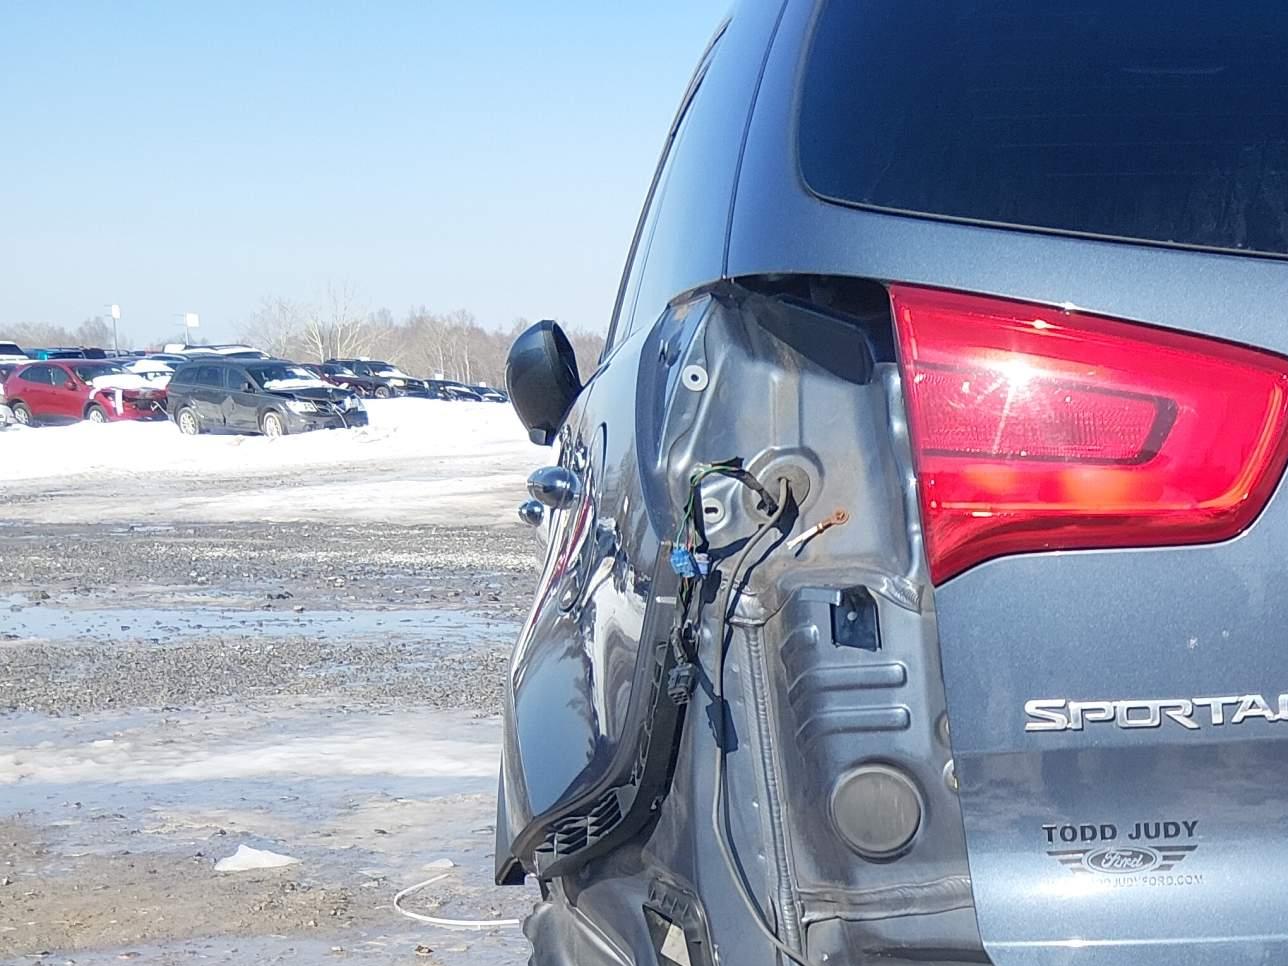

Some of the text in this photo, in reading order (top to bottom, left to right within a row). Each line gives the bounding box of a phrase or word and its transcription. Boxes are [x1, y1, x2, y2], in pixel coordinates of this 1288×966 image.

[1042, 820, 1199, 843] TODD JUDY
[1101, 851, 1145, 868] Ford
